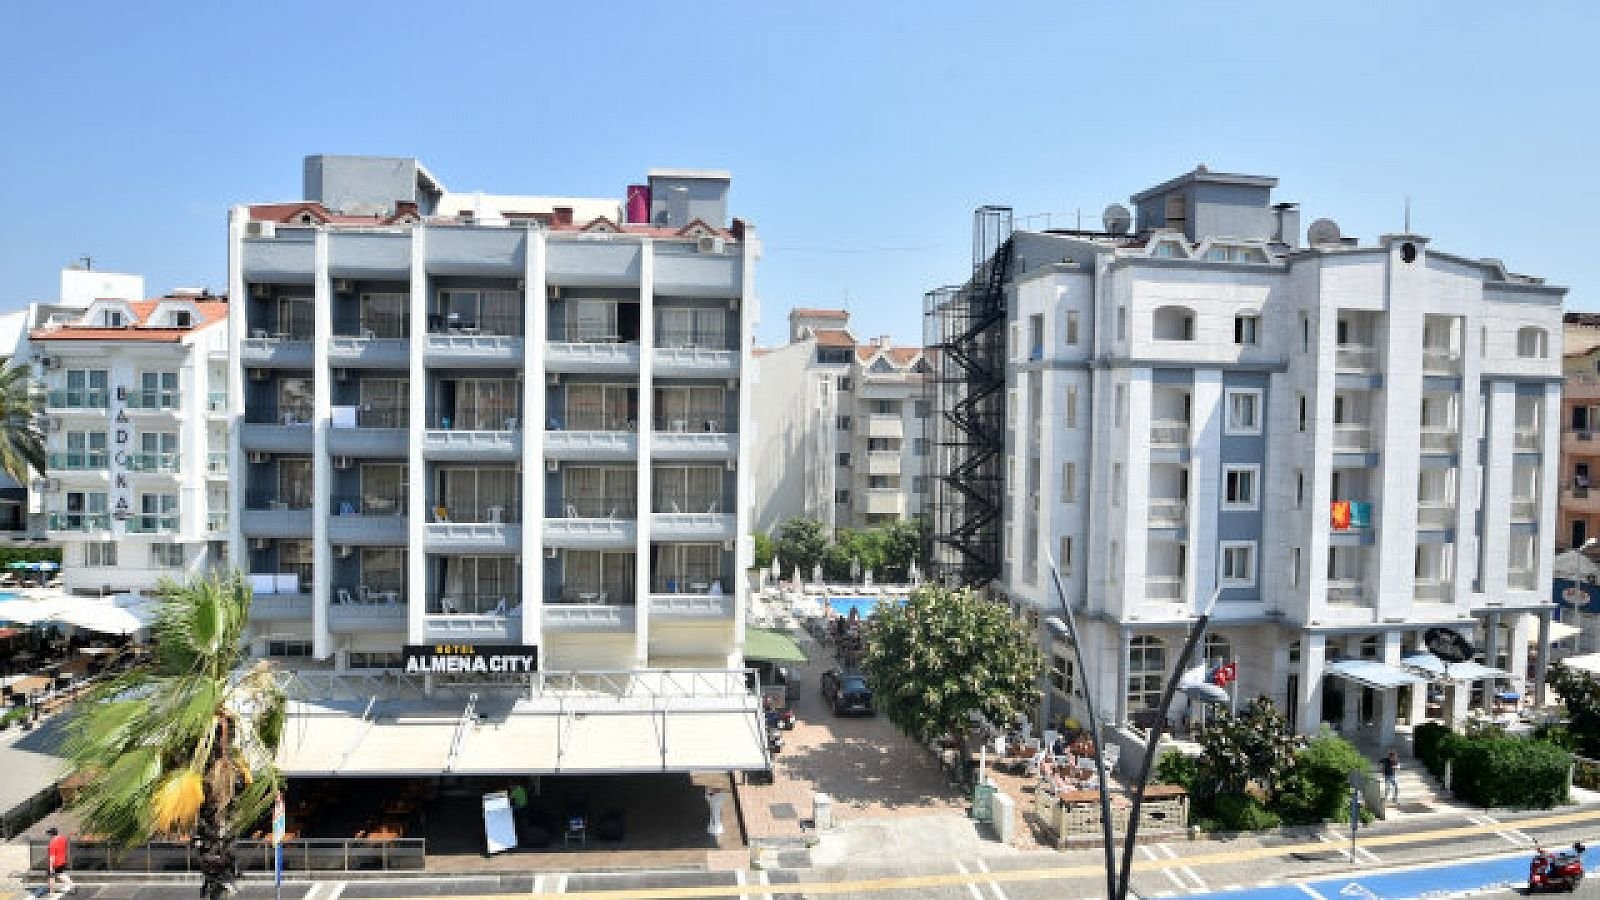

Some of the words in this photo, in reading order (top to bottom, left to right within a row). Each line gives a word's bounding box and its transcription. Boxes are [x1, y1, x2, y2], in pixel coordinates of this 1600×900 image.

[434, 644, 475, 654] HOTEL
[407, 655, 488, 671] ALMENA
[489, 655, 533, 671] CITY
